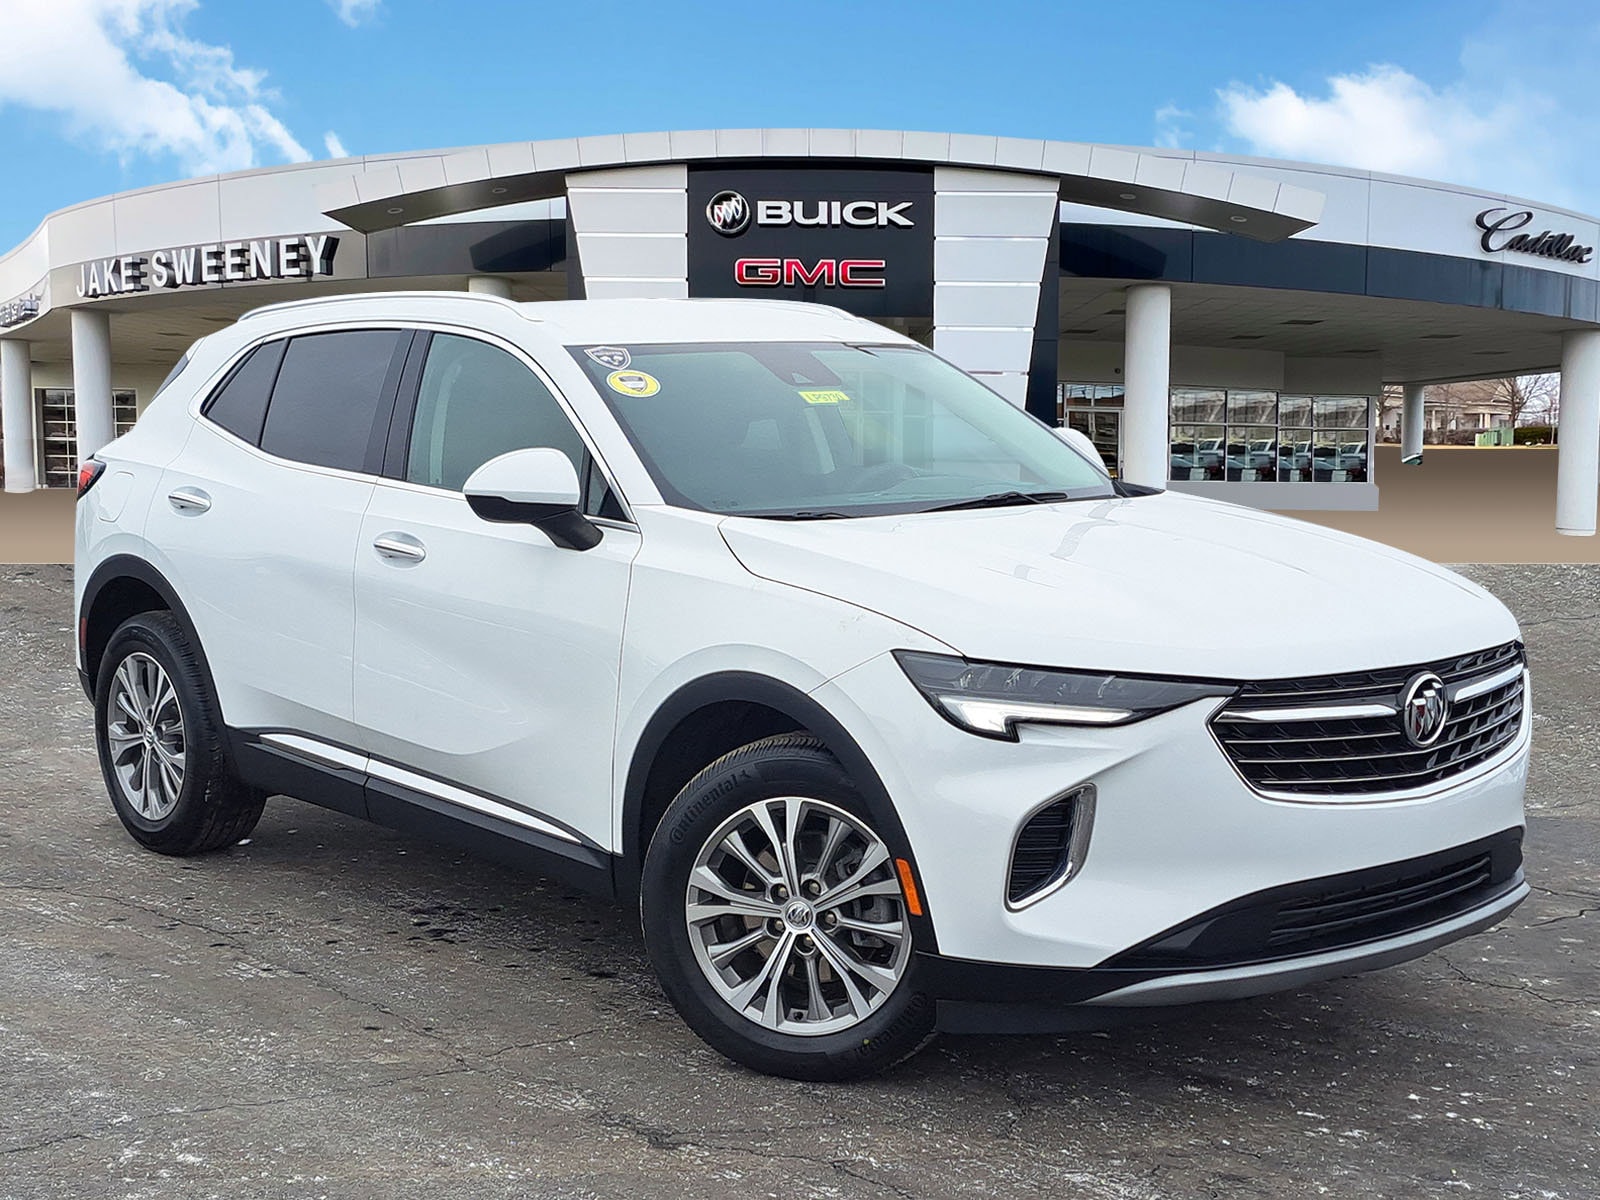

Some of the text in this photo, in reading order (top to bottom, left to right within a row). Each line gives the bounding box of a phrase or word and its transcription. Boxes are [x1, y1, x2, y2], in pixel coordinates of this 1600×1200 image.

[757, 200, 915, 226] BUICK
[1475, 207, 1593, 263] Cadillac
[76, 234, 334, 297] JAKE SWEENEY
[734, 258, 886, 286] GMC
[670, 773, 740, 845] Continental
